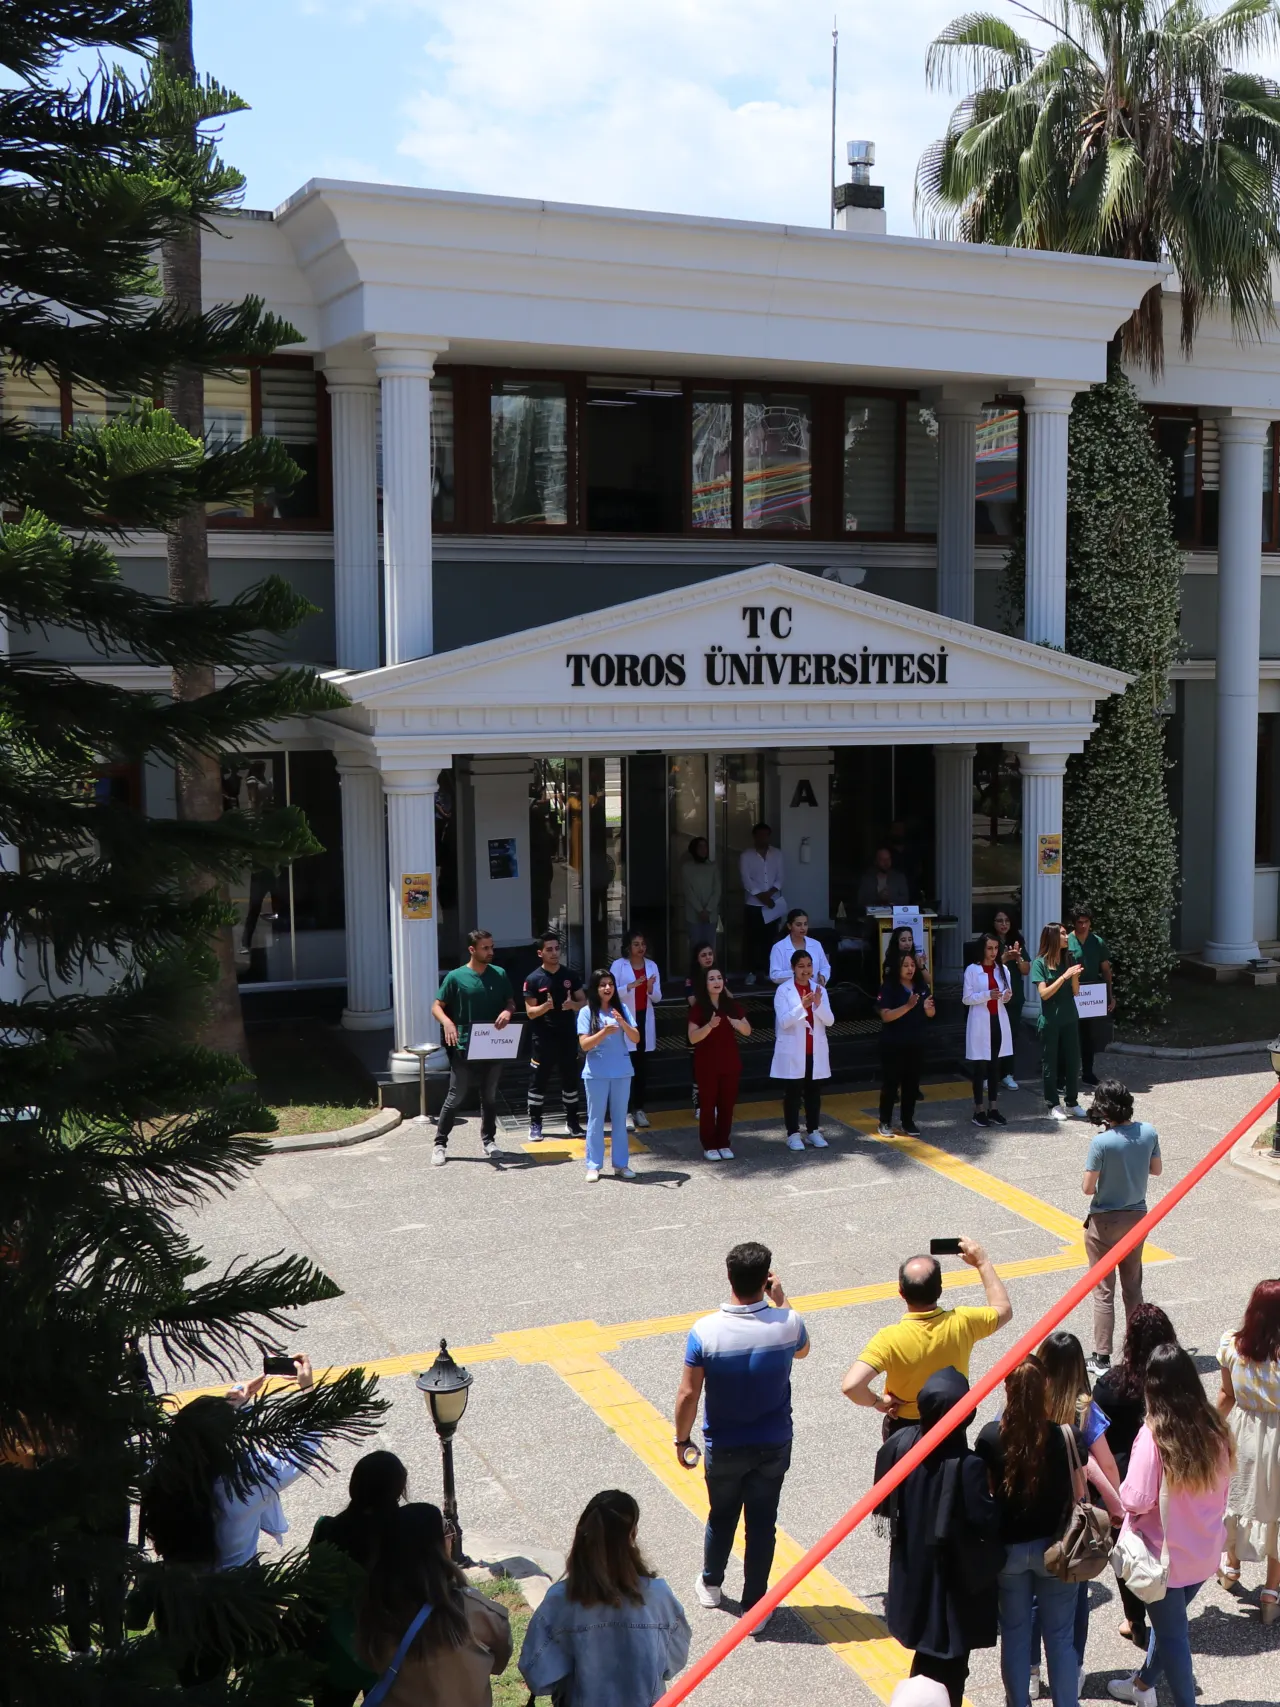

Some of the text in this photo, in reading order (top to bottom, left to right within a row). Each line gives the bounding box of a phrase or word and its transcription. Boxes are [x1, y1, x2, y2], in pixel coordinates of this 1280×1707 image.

[566, 645, 949, 687] TOROS ÜNİVERSİTESİ
[789, 779, 819, 808] A
